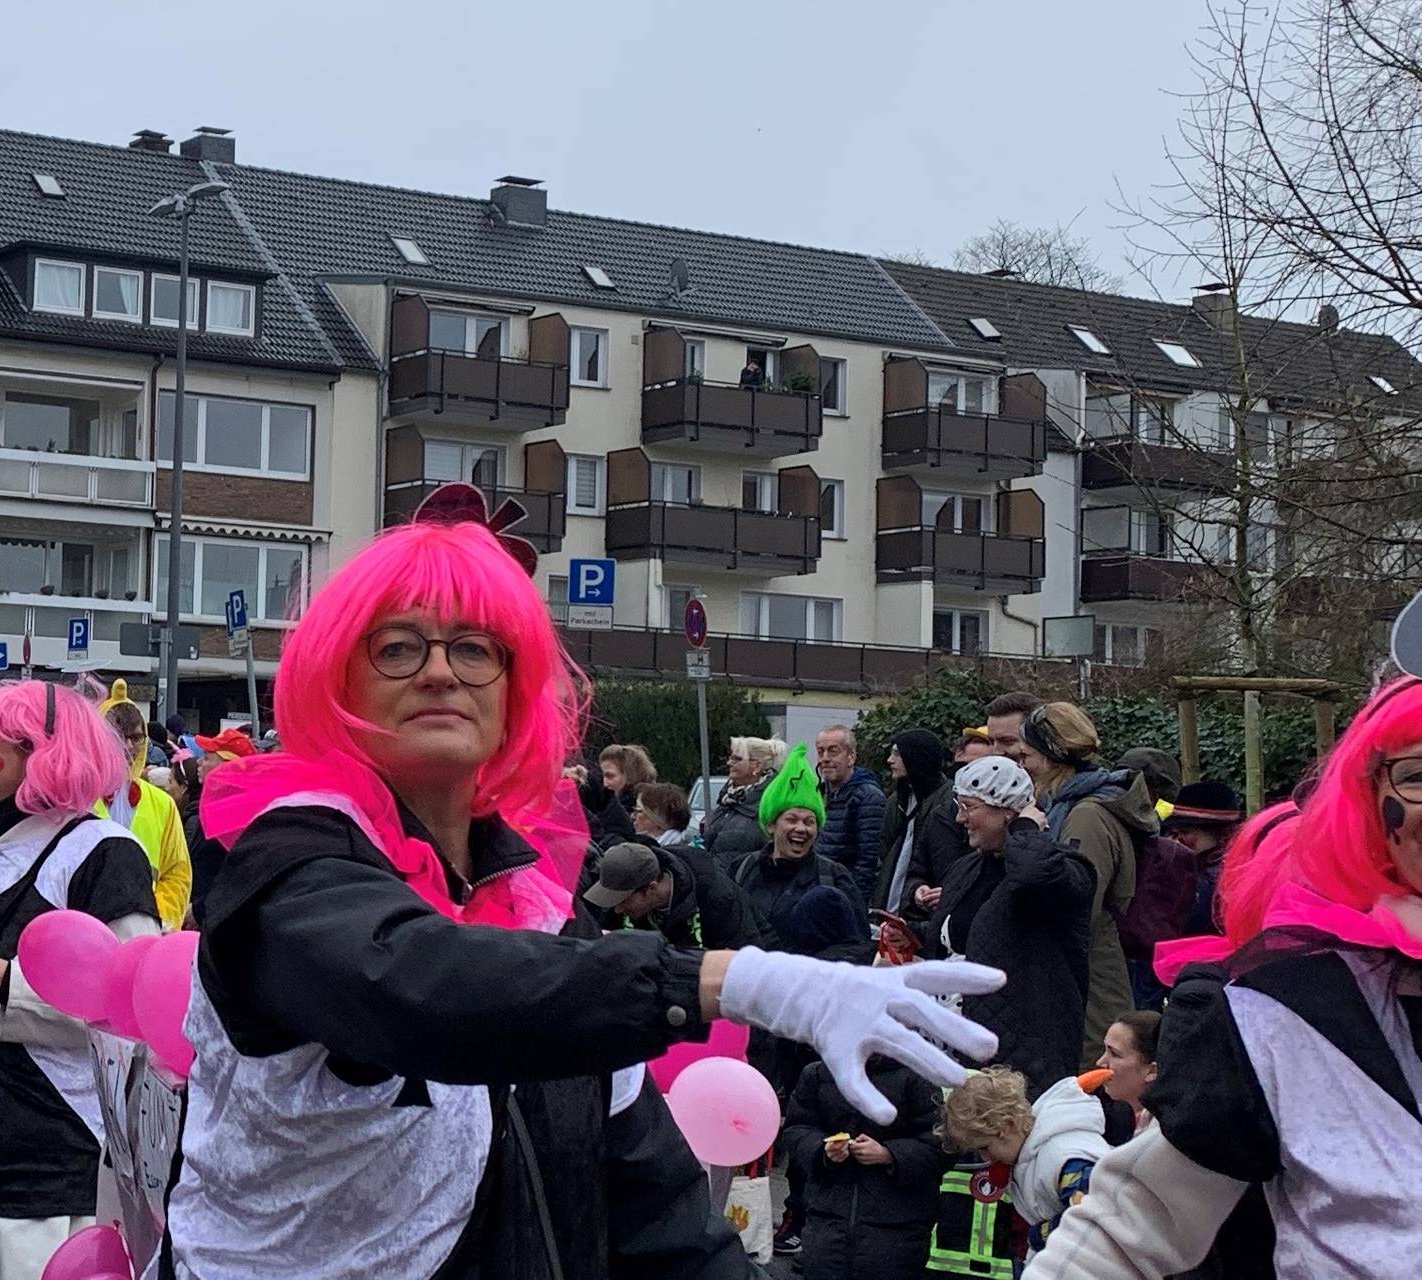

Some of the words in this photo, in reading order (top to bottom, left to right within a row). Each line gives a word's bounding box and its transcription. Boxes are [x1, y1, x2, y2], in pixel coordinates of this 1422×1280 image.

[579, 564, 604, 598] P
[233, 595, 242, 624] P
[72, 622, 85, 646] P
